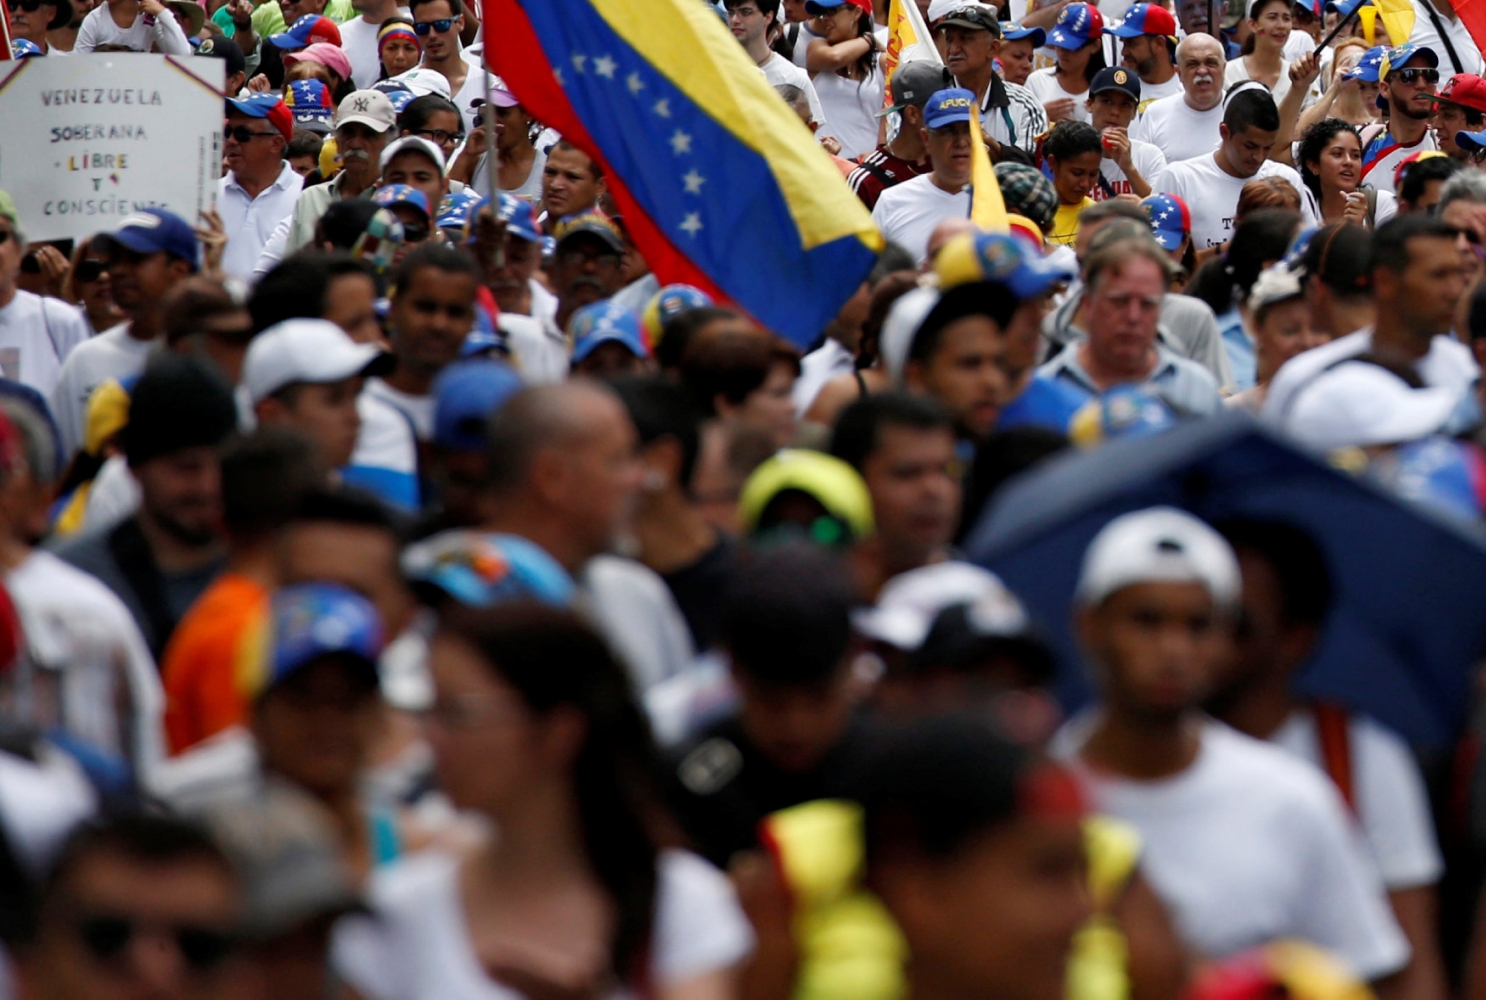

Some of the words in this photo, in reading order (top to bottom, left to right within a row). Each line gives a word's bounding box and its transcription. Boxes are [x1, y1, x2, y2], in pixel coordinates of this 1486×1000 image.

[41, 89, 162, 107] VENEZUELA
[51, 125, 148, 143] SOBERANA
[67, 151, 129, 171] LIBRE
[42, 196, 169, 216] CONSCIEN
